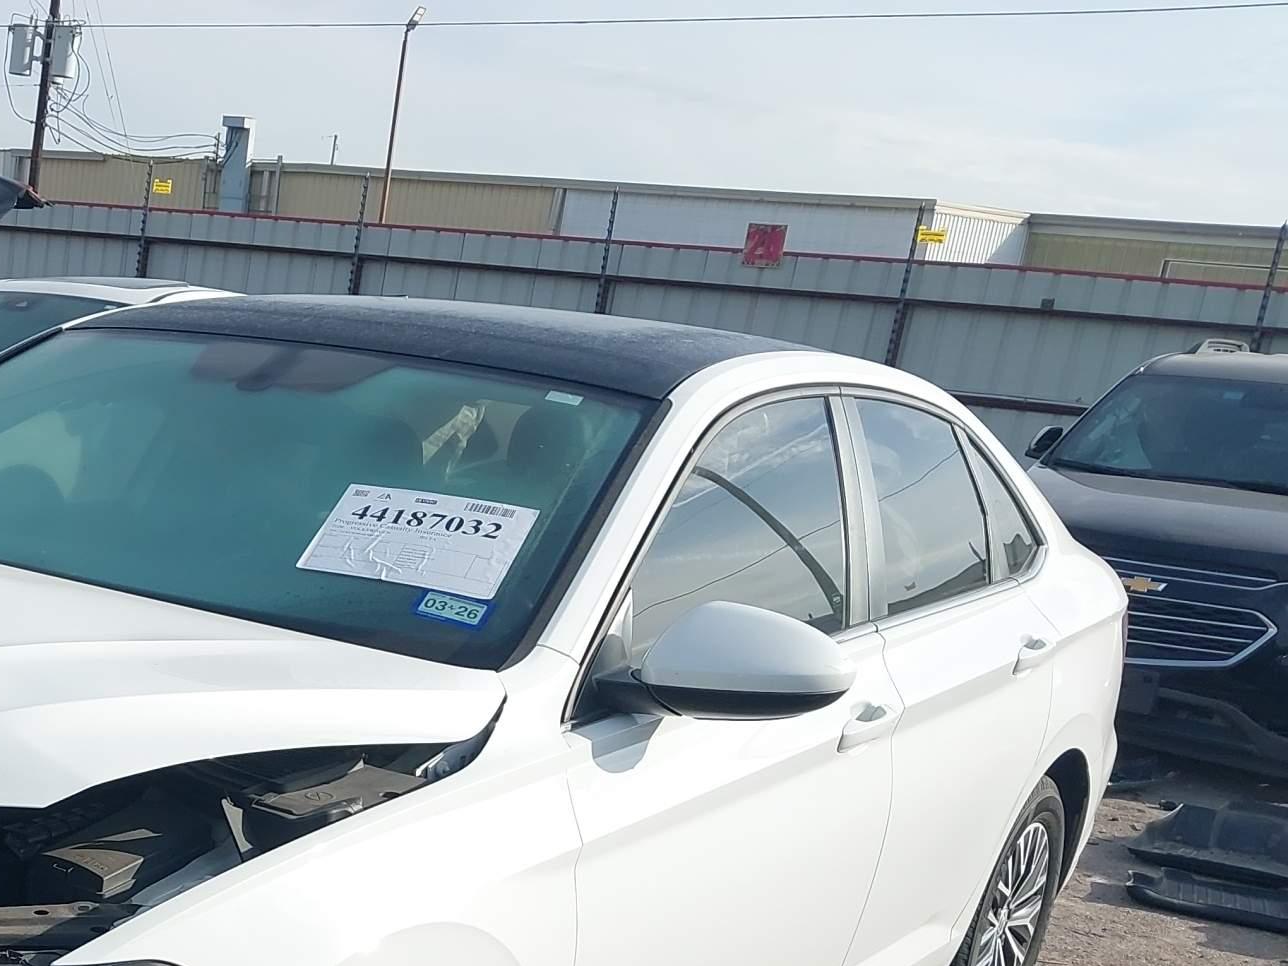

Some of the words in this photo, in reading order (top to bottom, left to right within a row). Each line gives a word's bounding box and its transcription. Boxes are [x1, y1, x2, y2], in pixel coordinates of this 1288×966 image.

[334, 518, 380, 529] Progressive
[414, 526, 453, 538] Insurance
[351, 504, 503, 540] 44187032
[424, 598, 448, 611] 03
[454, 605, 479, 619] 26
